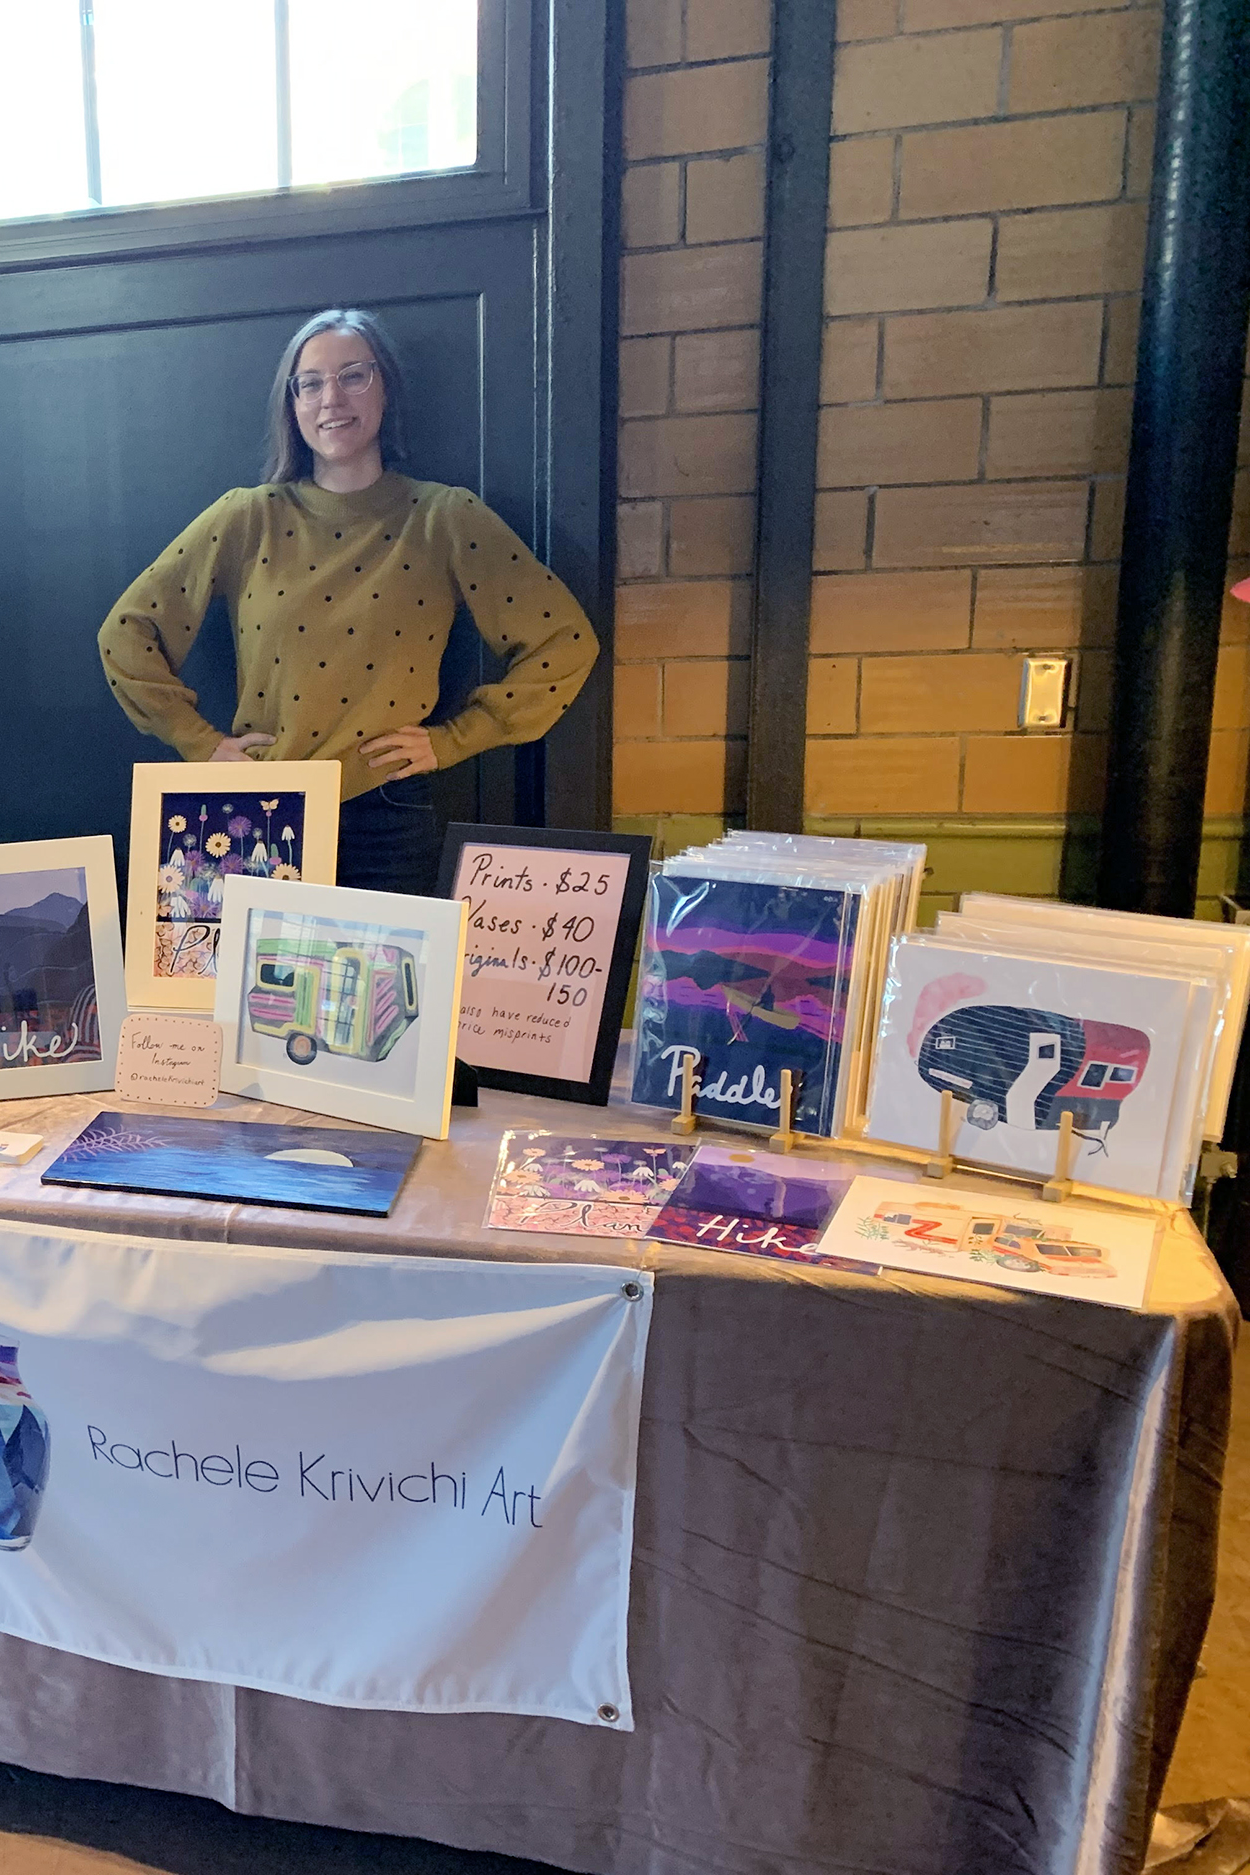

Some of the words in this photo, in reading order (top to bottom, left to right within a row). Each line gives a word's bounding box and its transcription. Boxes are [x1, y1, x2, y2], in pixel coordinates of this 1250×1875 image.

[470, 853, 533, 892] Prints
[555, 868, 610, 895] $25
[541, 912, 595, 942] $40
[464, 944, 527, 977] riginals
[546, 982, 587, 1007] 150
[459, 1005, 481, 1018] also
[492, 1006, 520, 1021] have
[526, 1012, 571, 1028] reduced
[131, 1031, 163, 1050] Follow
[493, 1027, 551, 1045] misprints
[520, 1201, 643, 1233] Plan
[697, 1215, 819, 1253] Hike
[87, 1425, 279, 1493] Rachele
[299, 1451, 467, 1510] Krivichi
[481, 1466, 543, 1528] Art
